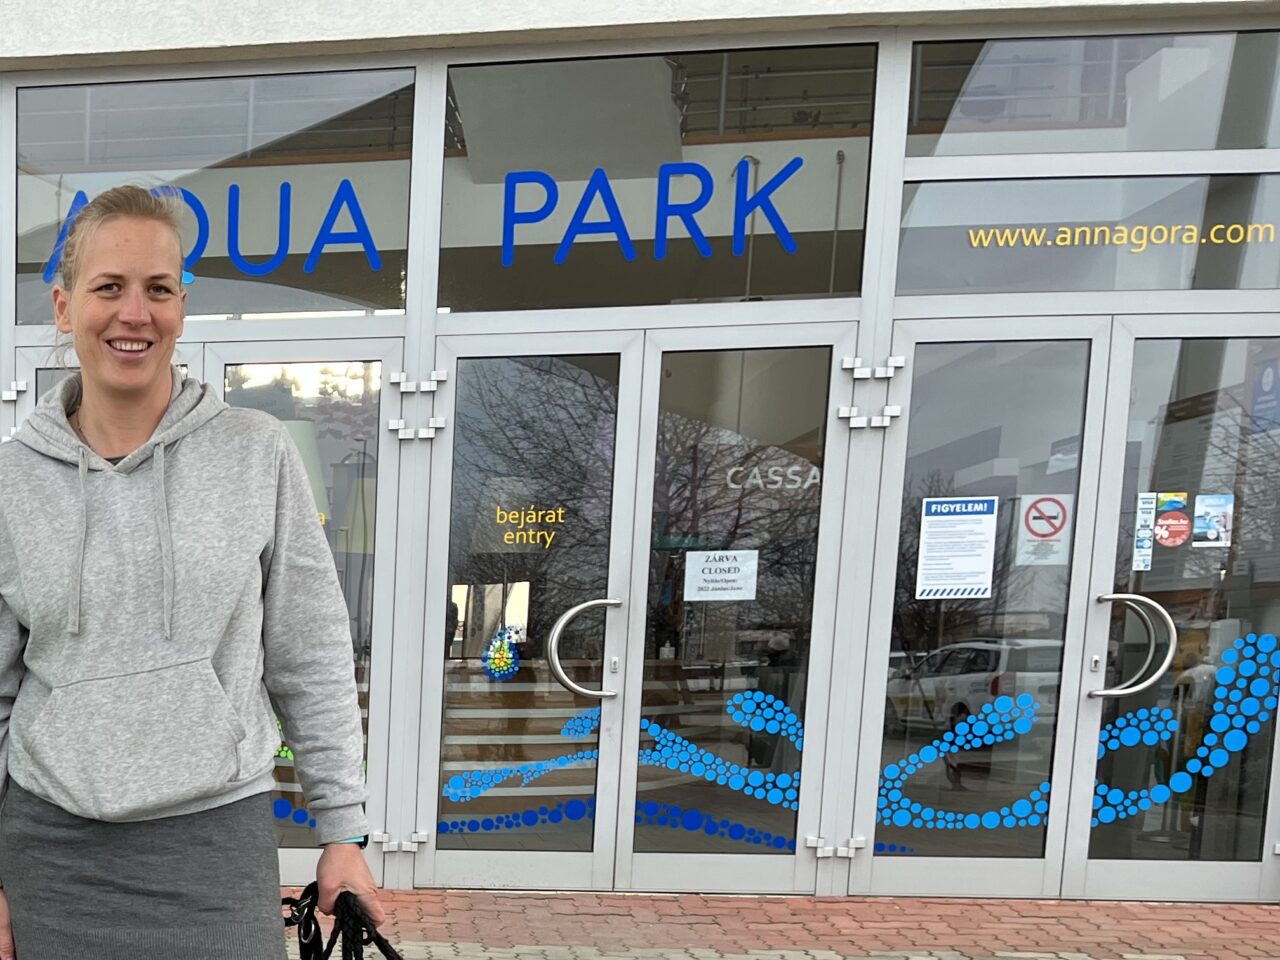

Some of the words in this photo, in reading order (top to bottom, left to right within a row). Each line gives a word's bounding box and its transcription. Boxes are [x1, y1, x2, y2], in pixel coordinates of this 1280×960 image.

[500, 156, 805, 268] PARK
[968, 223, 1274, 253] www.annagora.com
[726, 466, 821, 490] CASSA
[496, 505, 564, 528] bejárat
[931, 503, 987, 513] FIGYELEM!
[503, 529, 555, 548] entry
[705, 553, 738, 563] ZÁRVA
